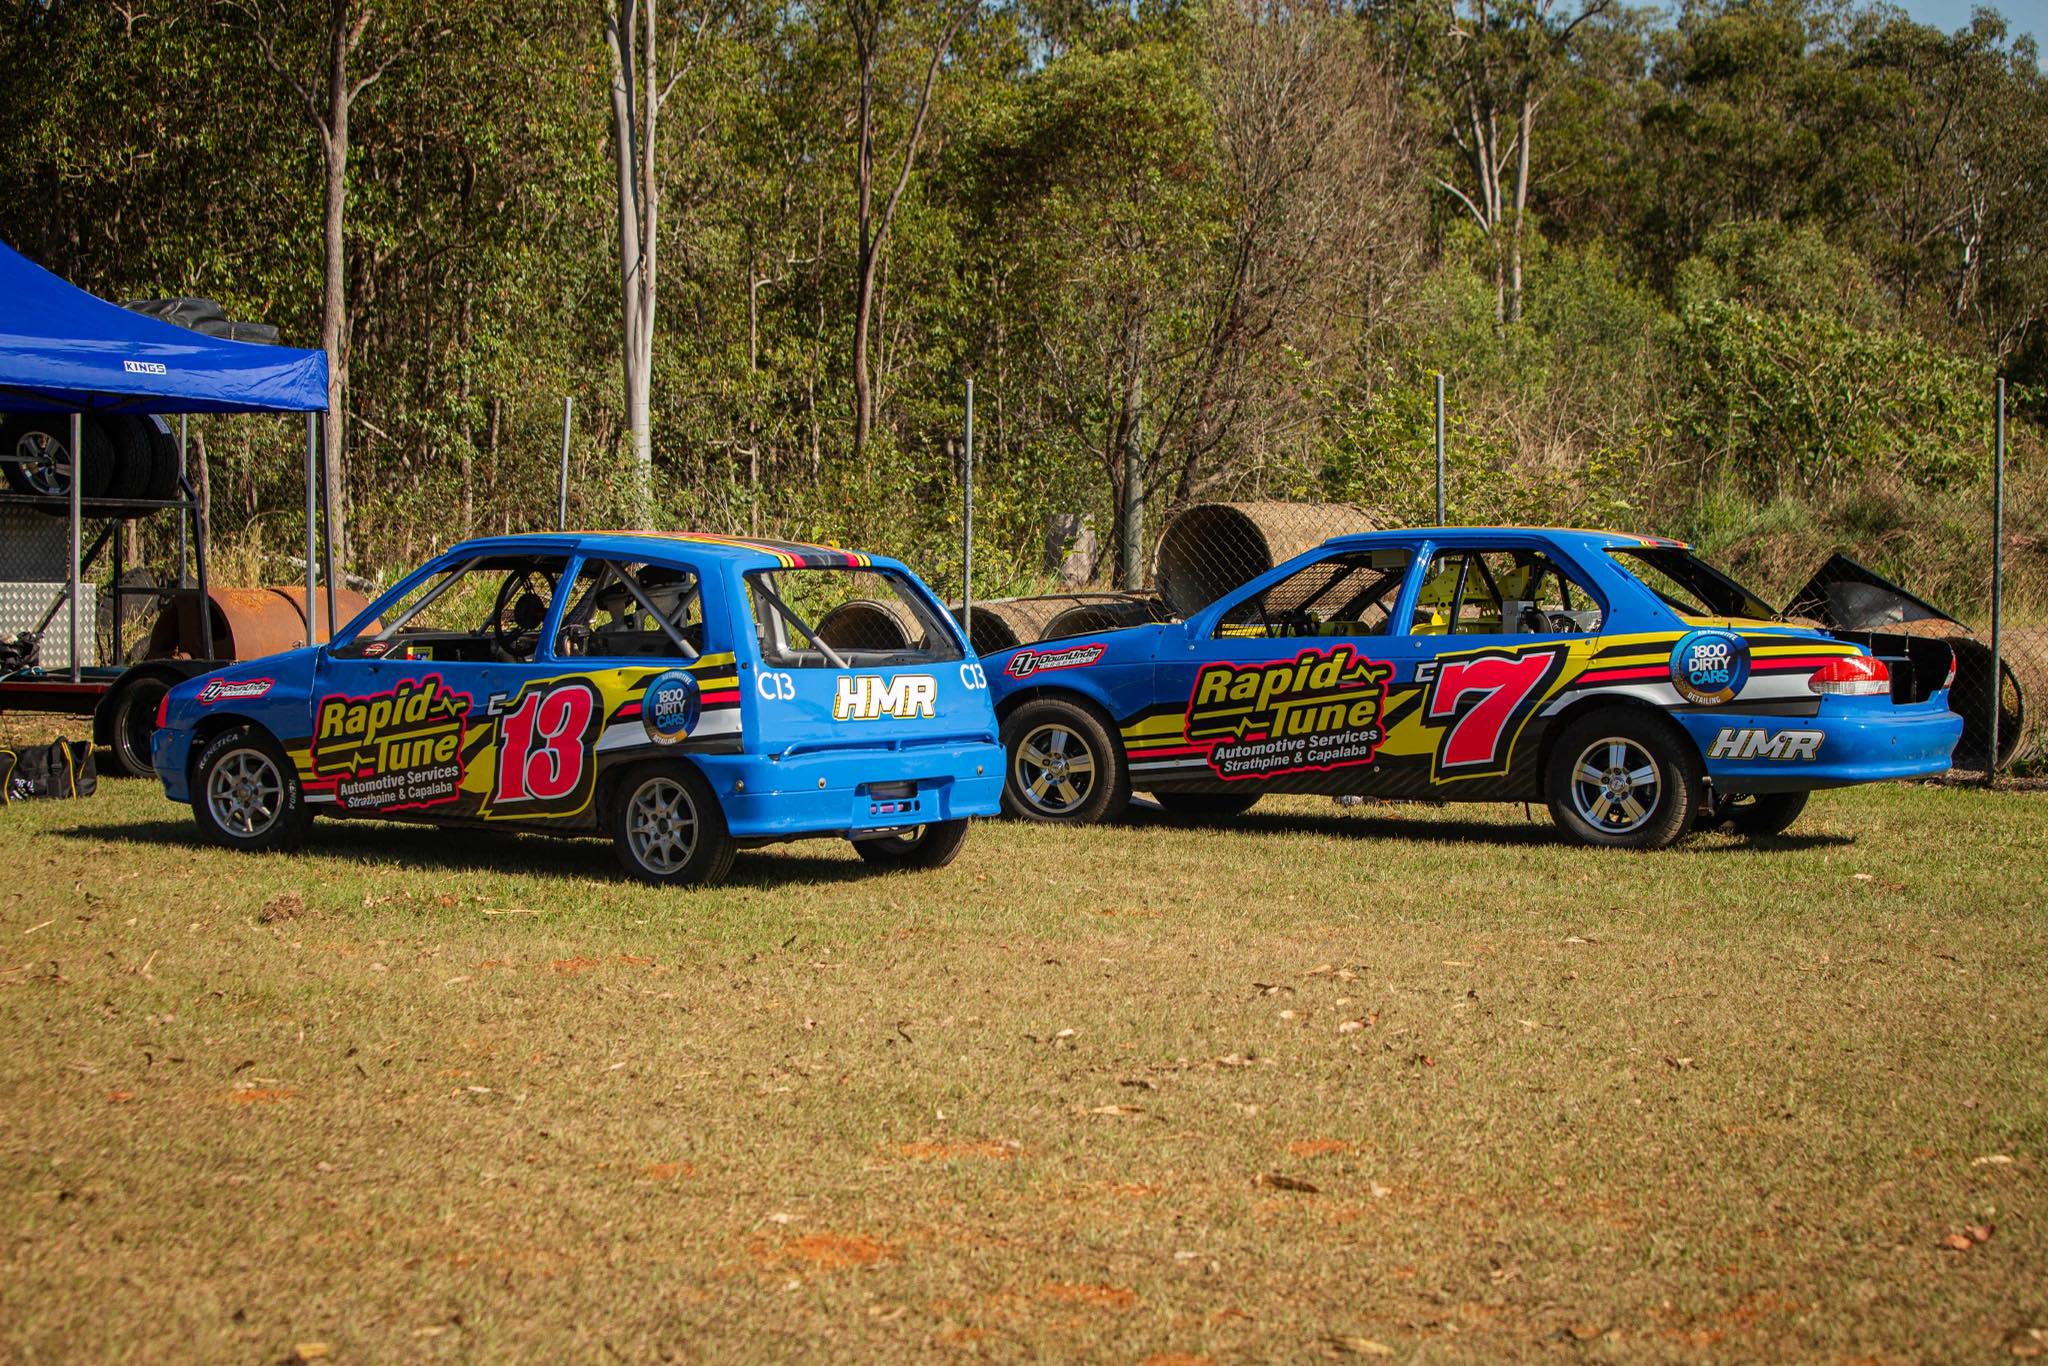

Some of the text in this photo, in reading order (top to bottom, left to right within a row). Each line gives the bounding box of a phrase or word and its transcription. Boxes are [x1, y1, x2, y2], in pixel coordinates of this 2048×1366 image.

[125, 361, 165, 373] KINGS
[1688, 656, 1731, 672] DIRTY
[1692, 643, 1728, 658] 1800
[757, 671, 796, 700] C13
[959, 664, 988, 690] C13
[1196, 652, 1348, 712] Rapid
[1690, 669, 1729, 685] CARS
[656, 700, 685, 716] DIRTY
[657, 688, 684, 704] 1800
[833, 674, 938, 721] HMR
[1429, 651, 1555, 768] 7
[1687, 692, 1721, 704] DETAILING
[320, 683, 435, 746] Rapid
[657, 713, 684, 728] CARS
[1268, 688, 1380, 738] Tune
[373, 722, 460, 774] Tune
[493, 685, 593, 803] 13
[1215, 729, 1378, 761] Automotive Services
[1707, 727, 1825, 760] HMR
[1223, 744, 1367, 772] Strathpine & Capalaba
[340, 765, 459, 797] Automotive Services
[347, 781, 453, 809] Strathpine & Capalaba
